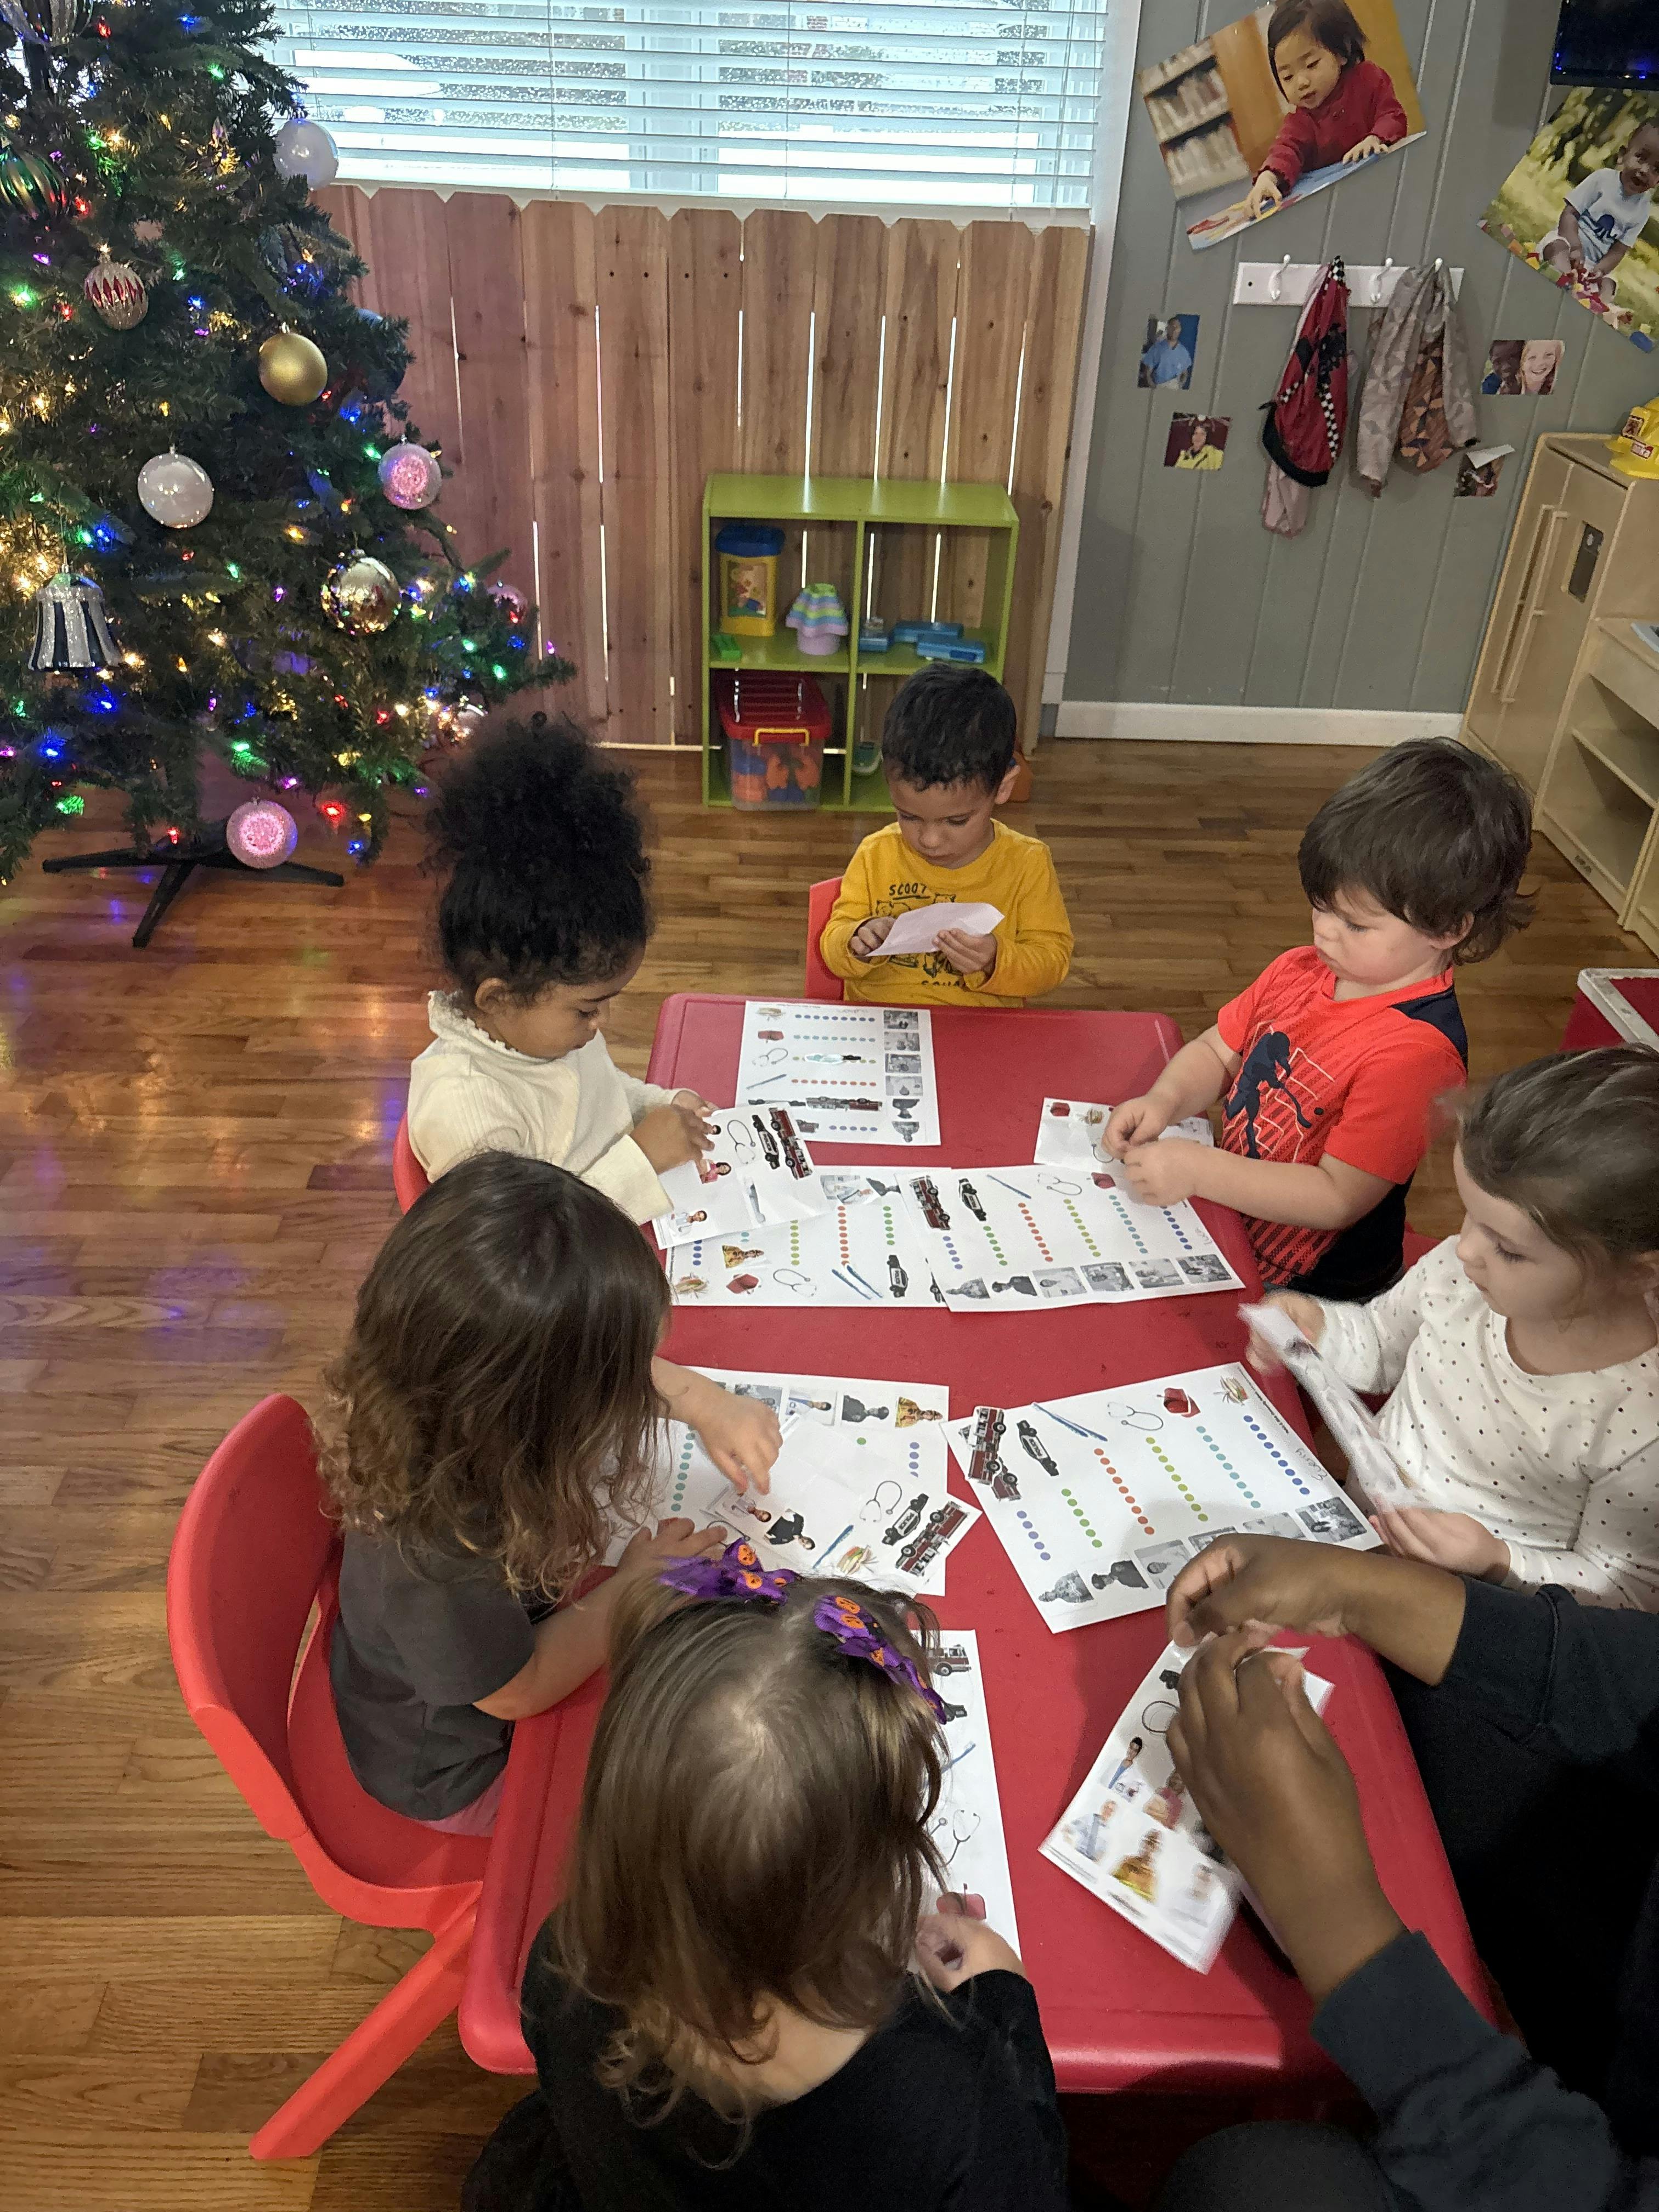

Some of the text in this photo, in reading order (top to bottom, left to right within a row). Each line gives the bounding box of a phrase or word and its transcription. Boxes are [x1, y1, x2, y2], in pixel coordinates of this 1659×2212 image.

[889, 882, 927, 896] SCOOT
[1029, 1438, 1043, 1456] POLICE
[898, 1512, 915, 1530] POLICE
